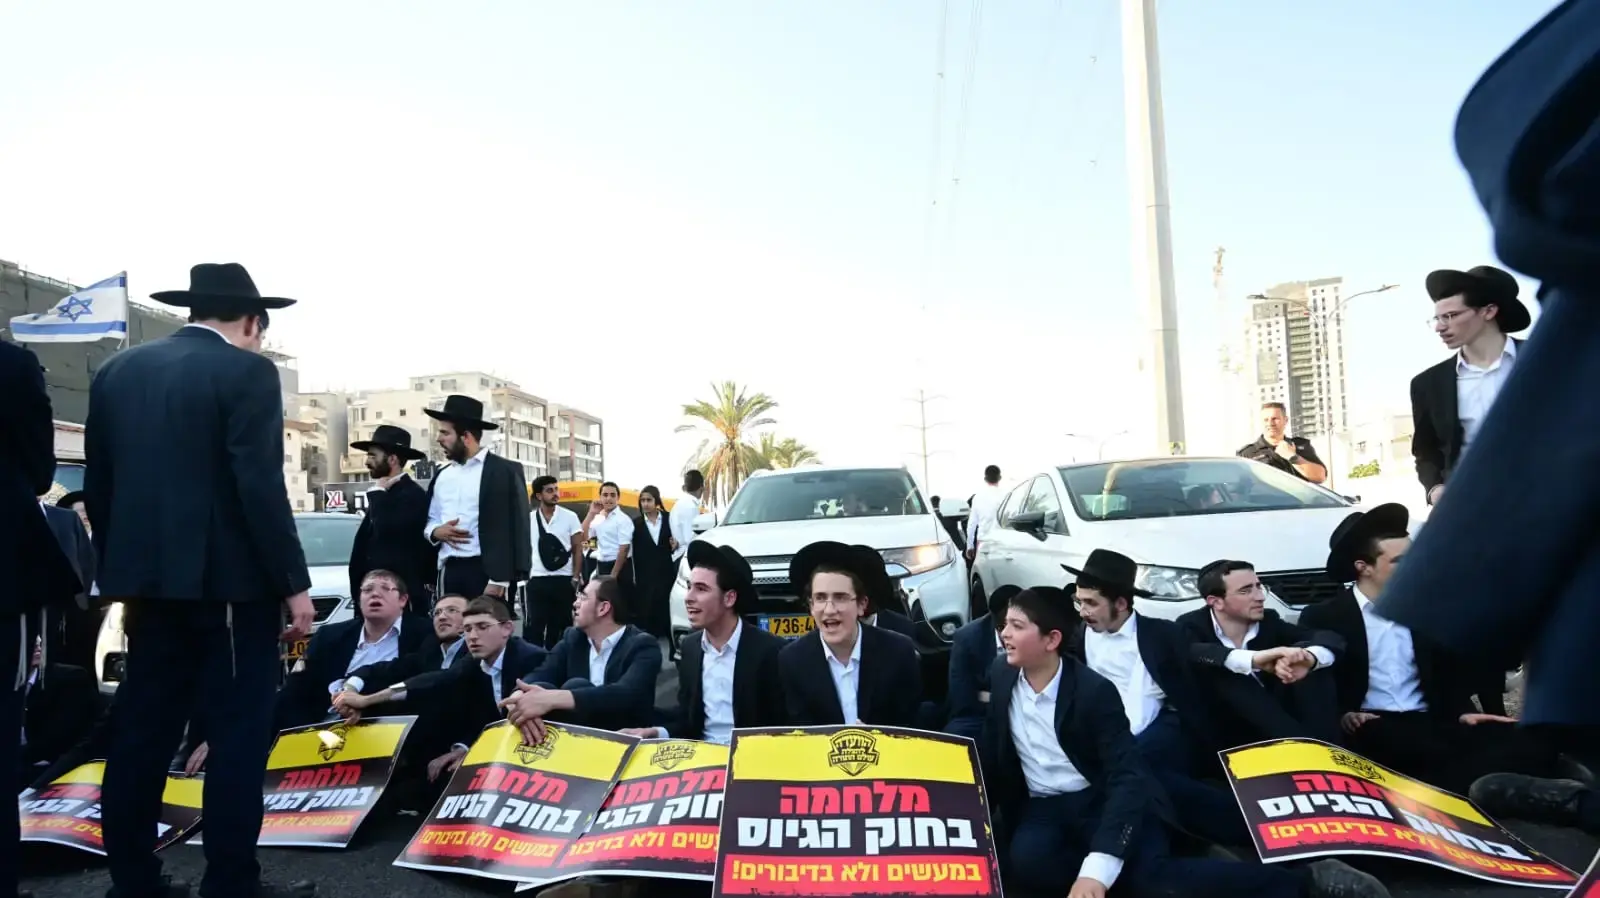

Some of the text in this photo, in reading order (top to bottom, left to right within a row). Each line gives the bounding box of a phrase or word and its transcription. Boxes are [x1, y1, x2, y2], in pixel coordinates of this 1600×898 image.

[326, 490, 347, 507] XL
[276, 763, 362, 791] מלחמה
[467, 766, 569, 804] מלחמה
[300, 786, 375, 812] בחוק
[657, 793, 724, 825] חוק
[780, 781, 931, 814] מלחמה
[436, 793, 582, 833] בחוק הגיוס
[1257, 793, 1533, 861] בחוק הגיוס
[465, 830, 495, 848] ולא
[492, 836, 560, 858] במעשים
[628, 831, 666, 848] ולא
[737, 817, 978, 855] בחוק הגיוס
[1267, 821, 1560, 876] במעשים ולא בדיבורים!
[732, 859, 982, 882] במעשים ולא בדיבורים!
